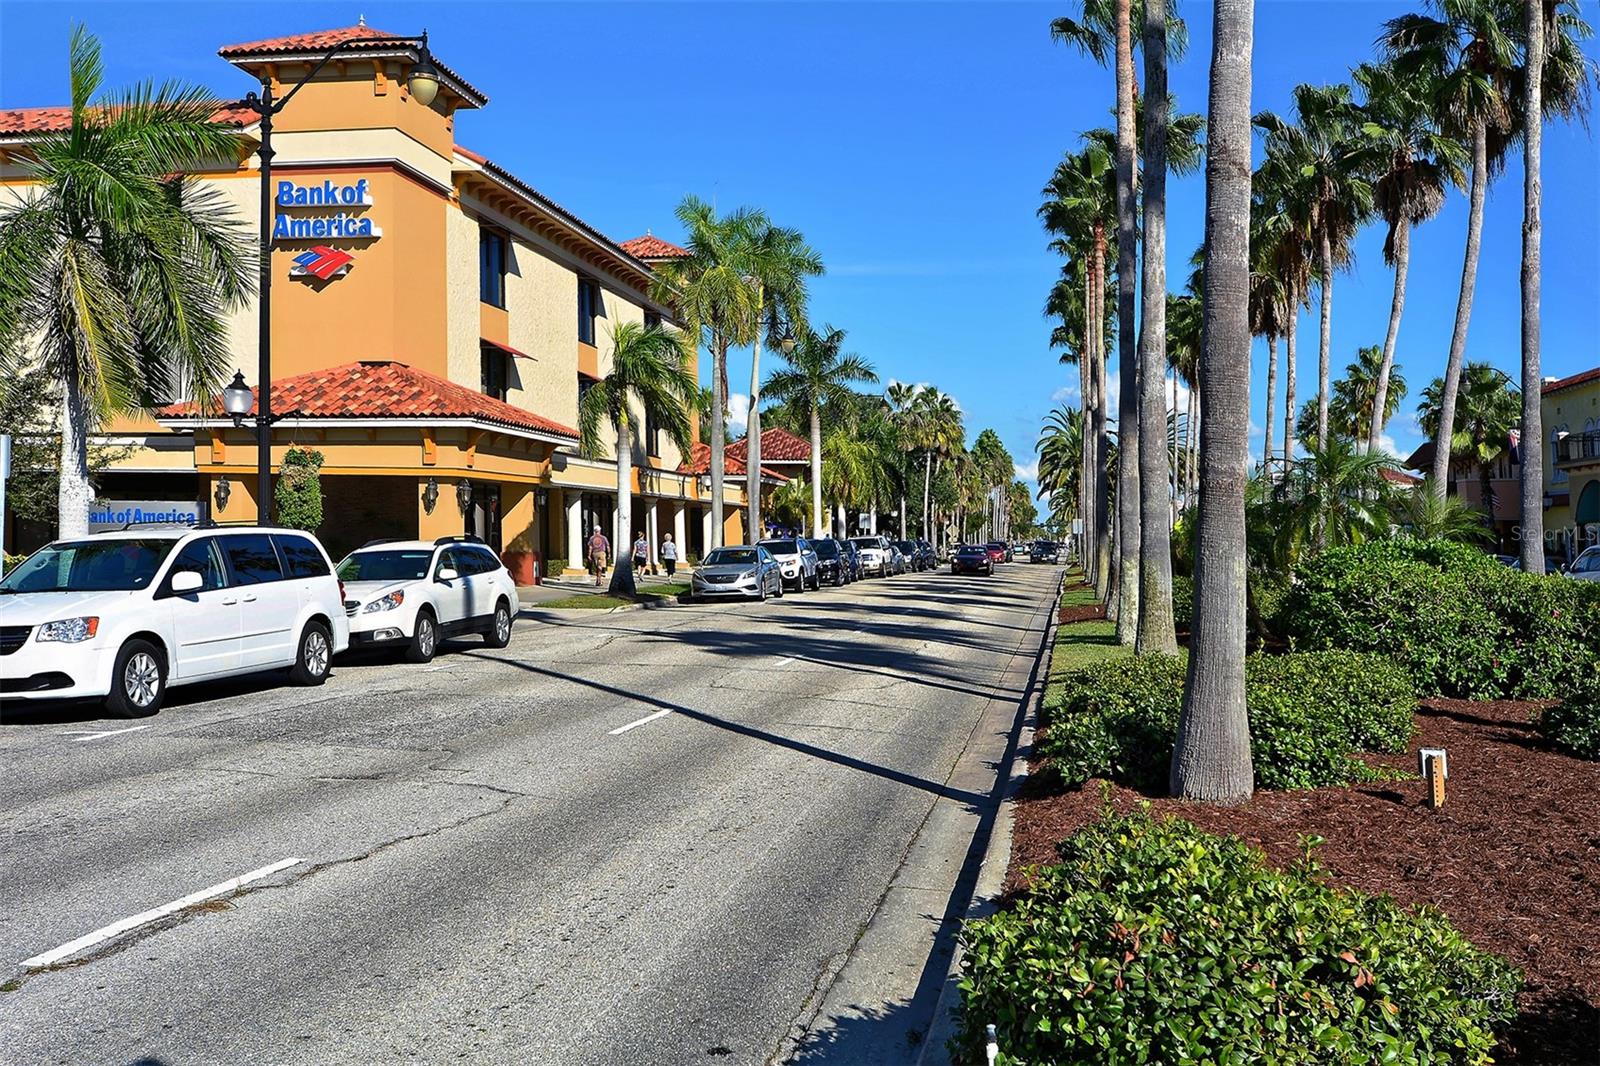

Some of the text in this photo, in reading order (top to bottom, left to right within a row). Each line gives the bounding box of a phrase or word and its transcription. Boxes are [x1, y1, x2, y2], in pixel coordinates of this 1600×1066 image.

[277, 178, 368, 206] Bank of
[273, 213, 374, 238] America
[89, 506, 195, 524] ank of America
